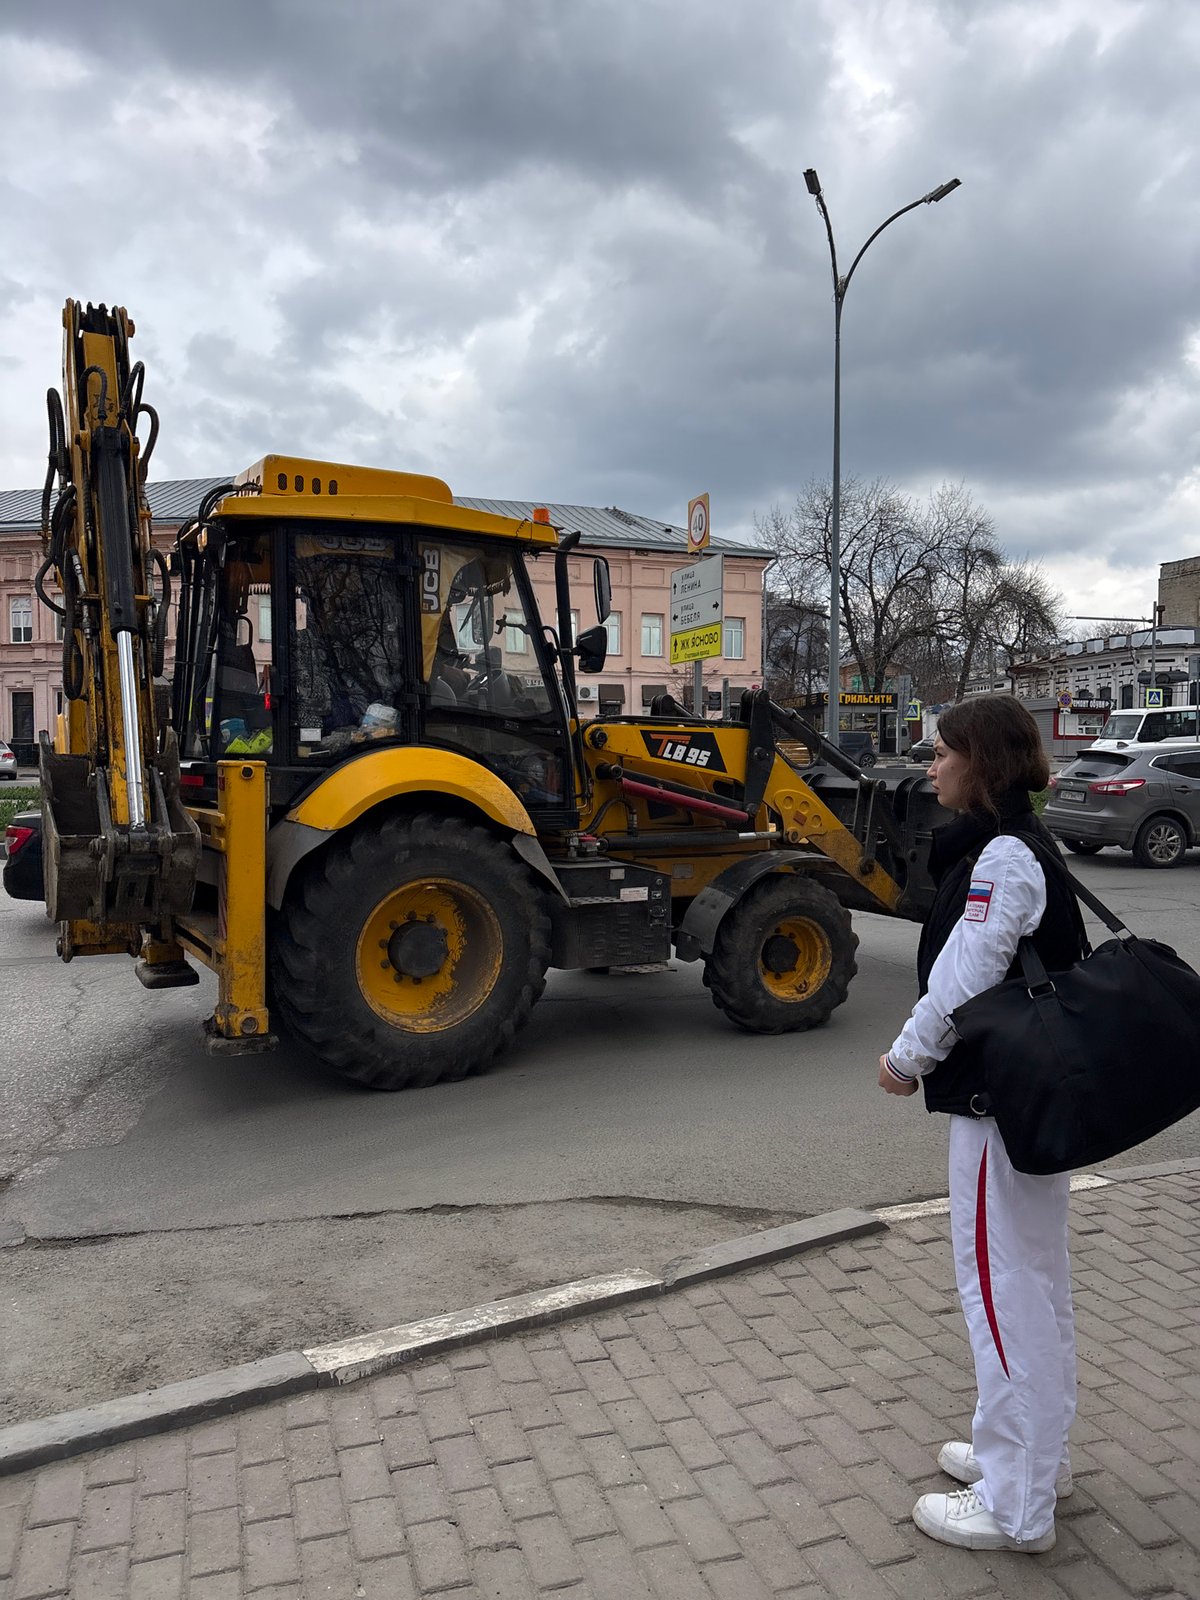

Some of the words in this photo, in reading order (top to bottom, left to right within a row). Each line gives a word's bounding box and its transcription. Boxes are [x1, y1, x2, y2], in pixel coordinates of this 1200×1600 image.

[692, 513, 704, 533] 40
[423, 549, 439, 611] JCB
[681, 571, 695, 583] улица
[680, 579, 701, 594] ЛЕНИНА
[680, 603, 694, 615] улица
[680, 611, 701, 625] БЕБЕЛЯ
[680, 637, 690, 651] ЖК
[685, 747, 712, 767] 95
